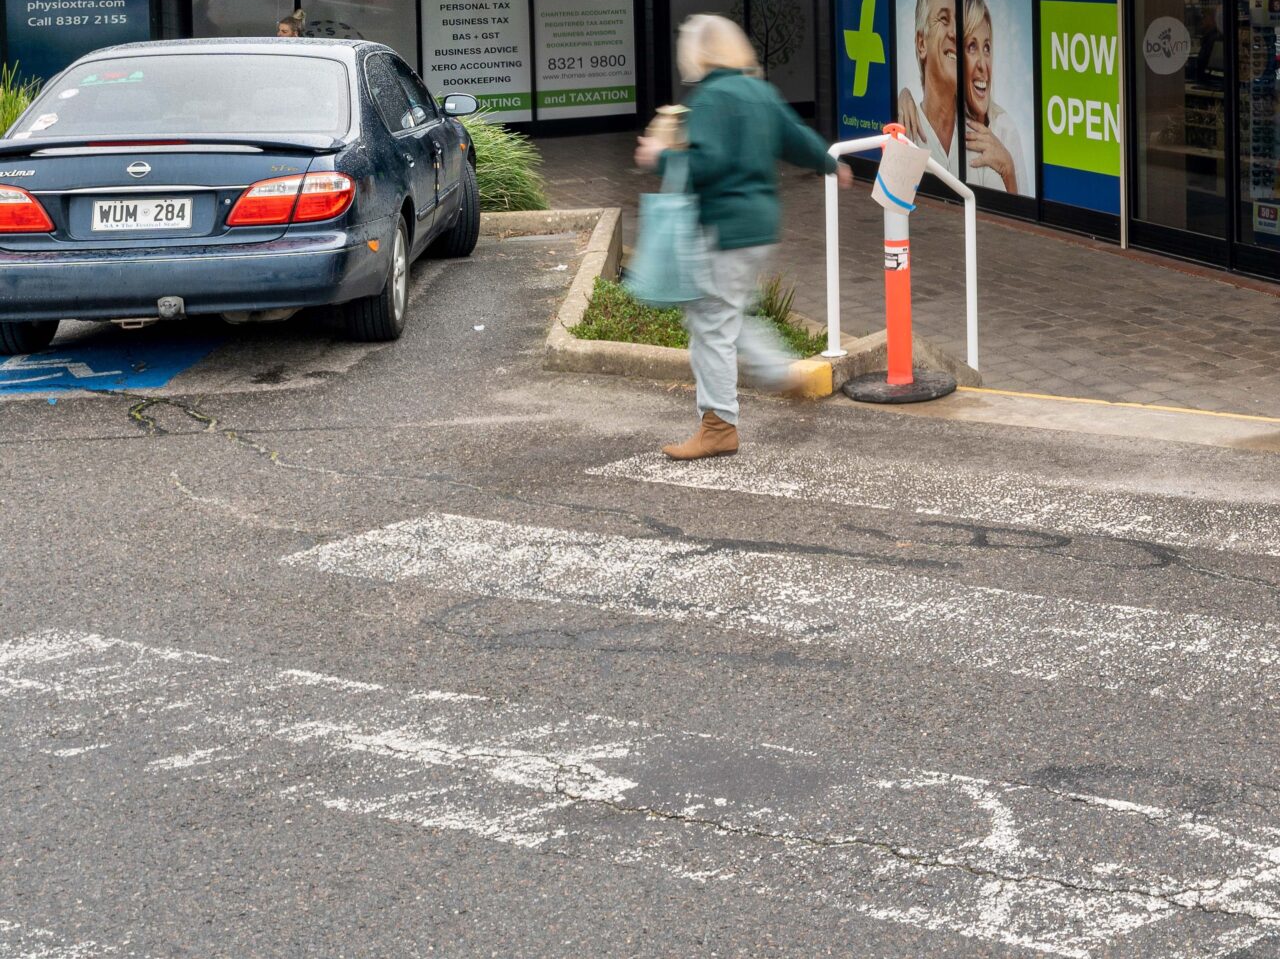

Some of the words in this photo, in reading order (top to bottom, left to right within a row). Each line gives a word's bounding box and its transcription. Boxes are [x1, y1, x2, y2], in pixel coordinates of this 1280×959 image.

[27, 0, 125, 11] physioxtra.com
[440, 3, 490, 11] PERSONAL
[27, 17, 51, 26] Call
[56, 15, 89, 25] 8387
[94, 14, 127, 24] 2155
[442, 18, 489, 26] BUSINESS
[452, 33, 471, 41] BAS
[434, 47, 482, 56] BUSINESS
[484, 46, 518, 54] ADVICE
[1051, 31, 1117, 75] NOW
[431, 63, 458, 72] XERO
[460, 60, 522, 70] ACCOUNTING
[548, 57, 583, 71] 8321
[590, 54, 626, 68] 9800
[443, 75, 512, 86] BOOKKEEPING
[544, 94, 566, 104] and
[569, 90, 628, 102] TAXATION
[1047, 95, 1120, 143] OPEN
[99, 205, 138, 223] WUM
[154, 202, 186, 221] 284
